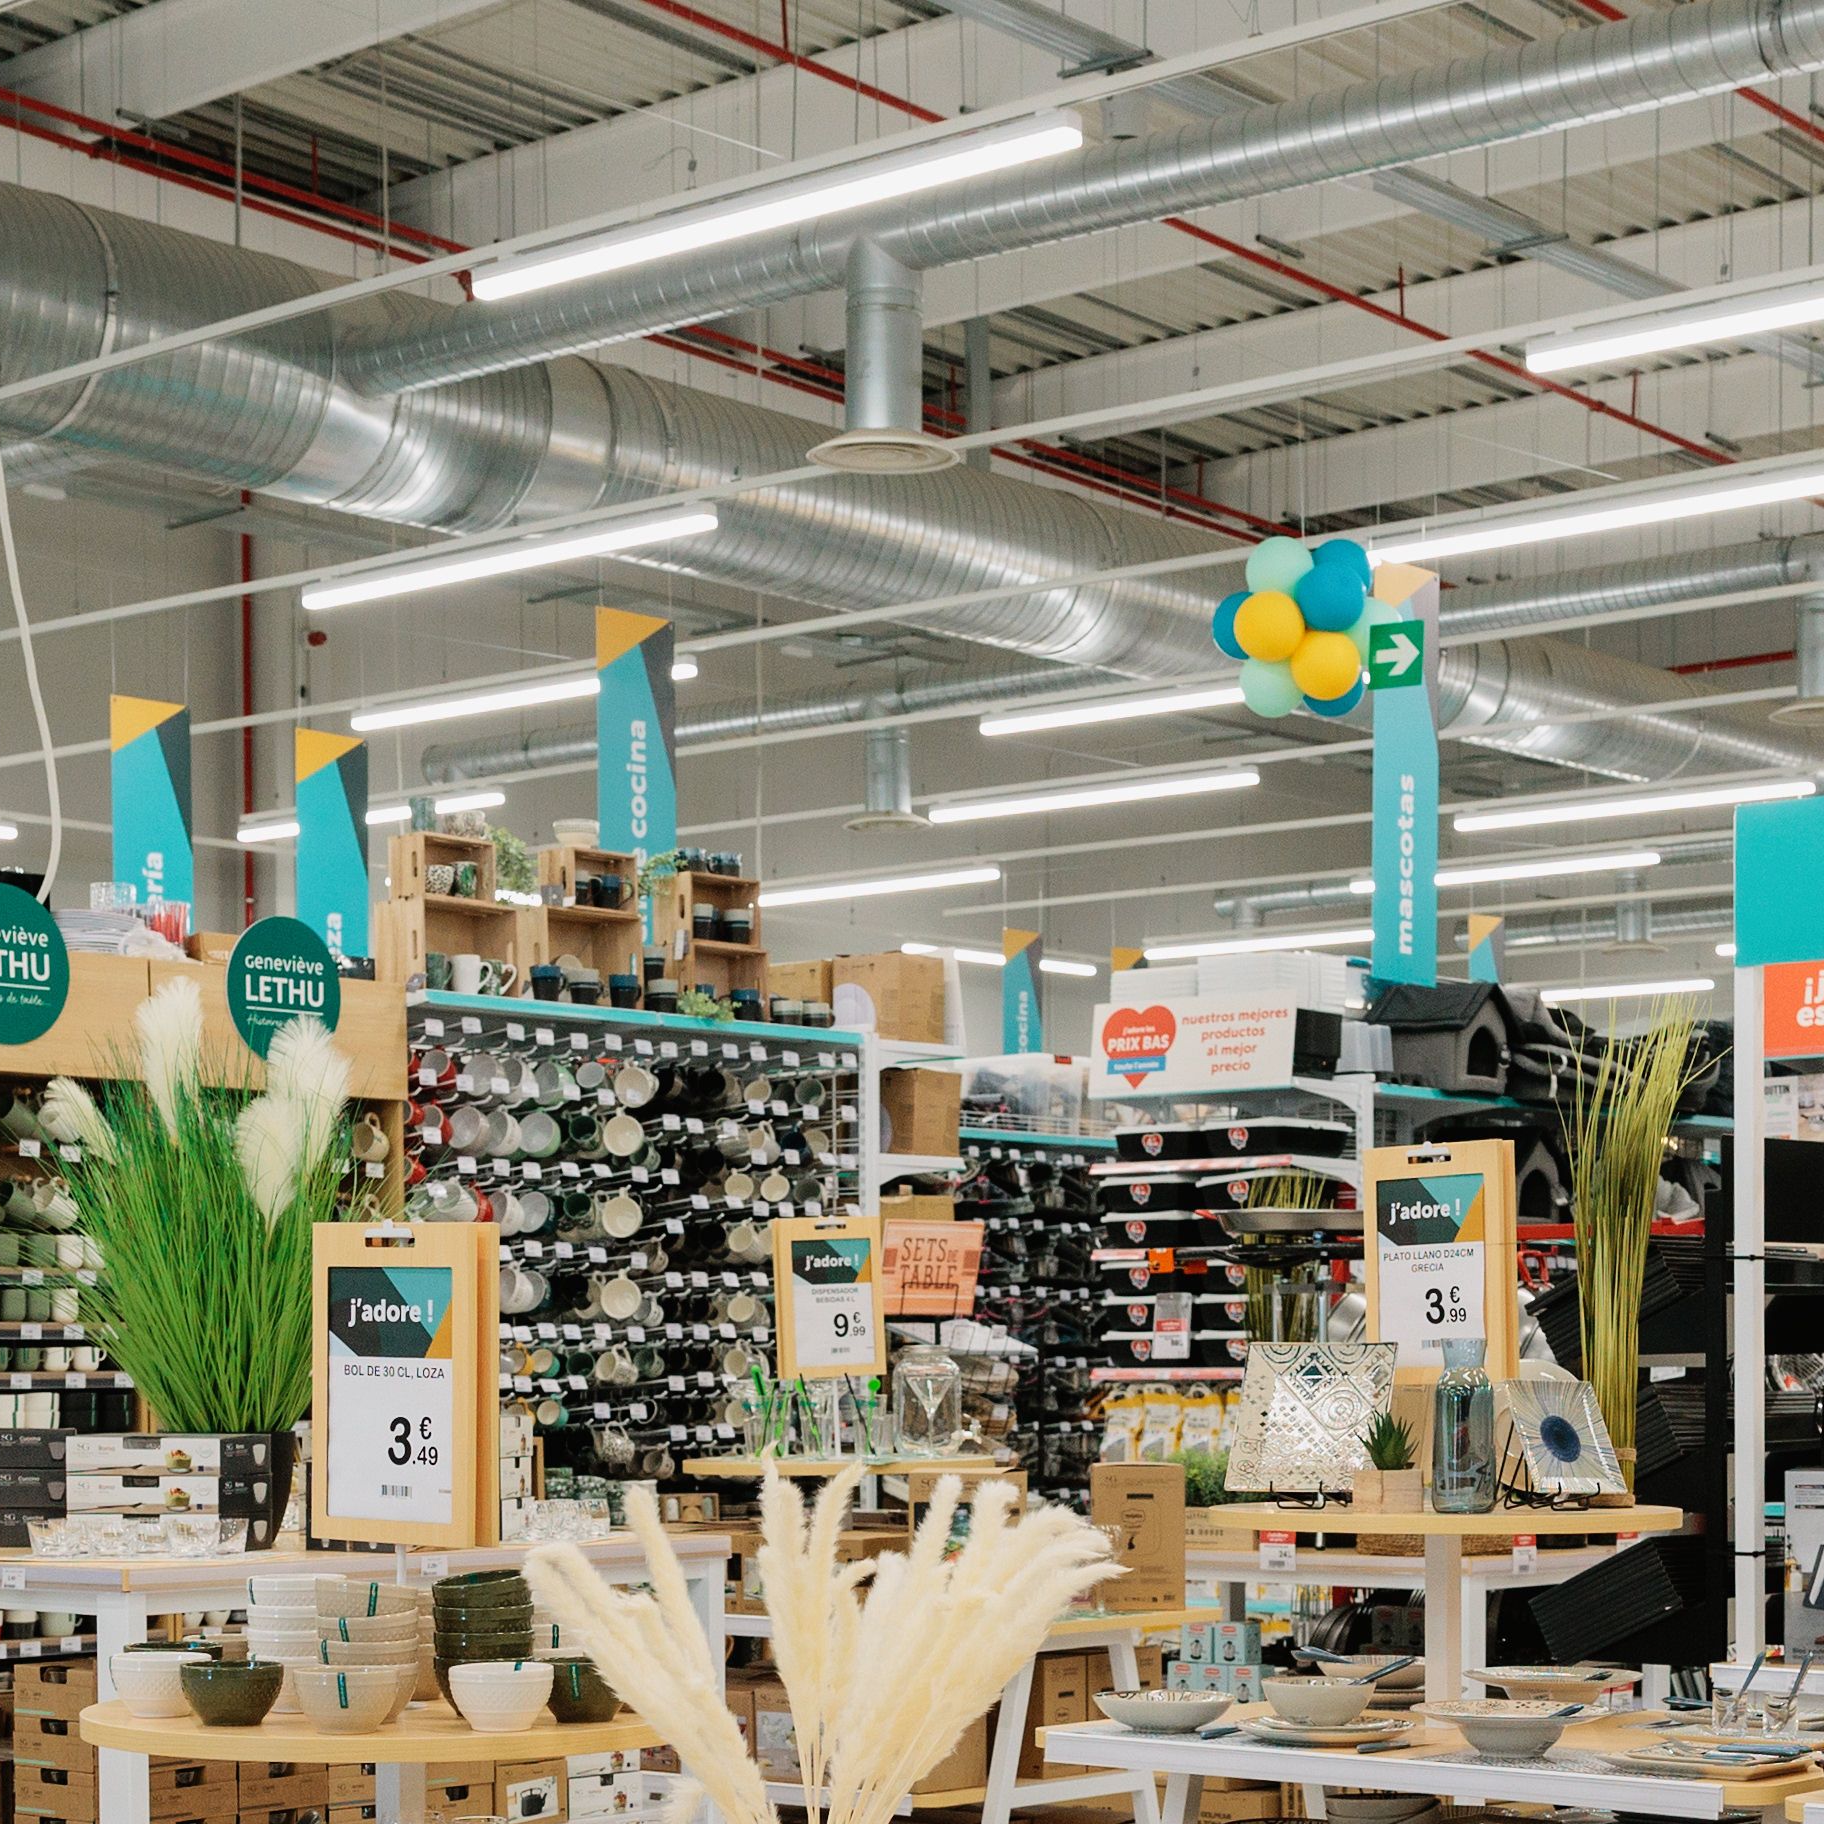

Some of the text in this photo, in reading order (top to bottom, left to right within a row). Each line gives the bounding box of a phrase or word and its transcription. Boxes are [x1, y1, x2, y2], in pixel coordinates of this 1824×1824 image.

[626, 719, 647, 836] cocina
[1397, 773, 1415, 955] mascotas
[6, 991, 17, 1005] de
[244, 974, 325, 1008] LETHU
[1181, 1007, 1288, 1025] nuestros mejores
[1201, 1025, 1265, 1042] productos
[1107, 1034, 1170, 1053] PRIX BAS
[1206, 1043, 1257, 1057] al mejor
[1211, 1060, 1251, 1075] precio
[1389, 1201, 1451, 1225] j'adore
[900, 1237, 948, 1263] SETS
[1383, 1248, 1474, 1262] PLATO LLANO D24CM
[804, 1254, 852, 1271] j'adore
[1411, 1263, 1444, 1273] GRECIA
[900, 1264, 958, 1289] TABLE
[811, 1287, 858, 1295] DISPENSADOR
[348, 1298, 422, 1327] j'adore
[1425, 1288, 1445, 1324] 3
[1450, 1285, 1460, 1303] €
[833, 1313, 849, 1338] 9
[853, 1312, 861, 1323] €
[344, 1364, 445, 1379] BOL DE 30 CL, LOZA
[388, 1416, 412, 1465] 3
[419, 1416, 432, 1440] €
